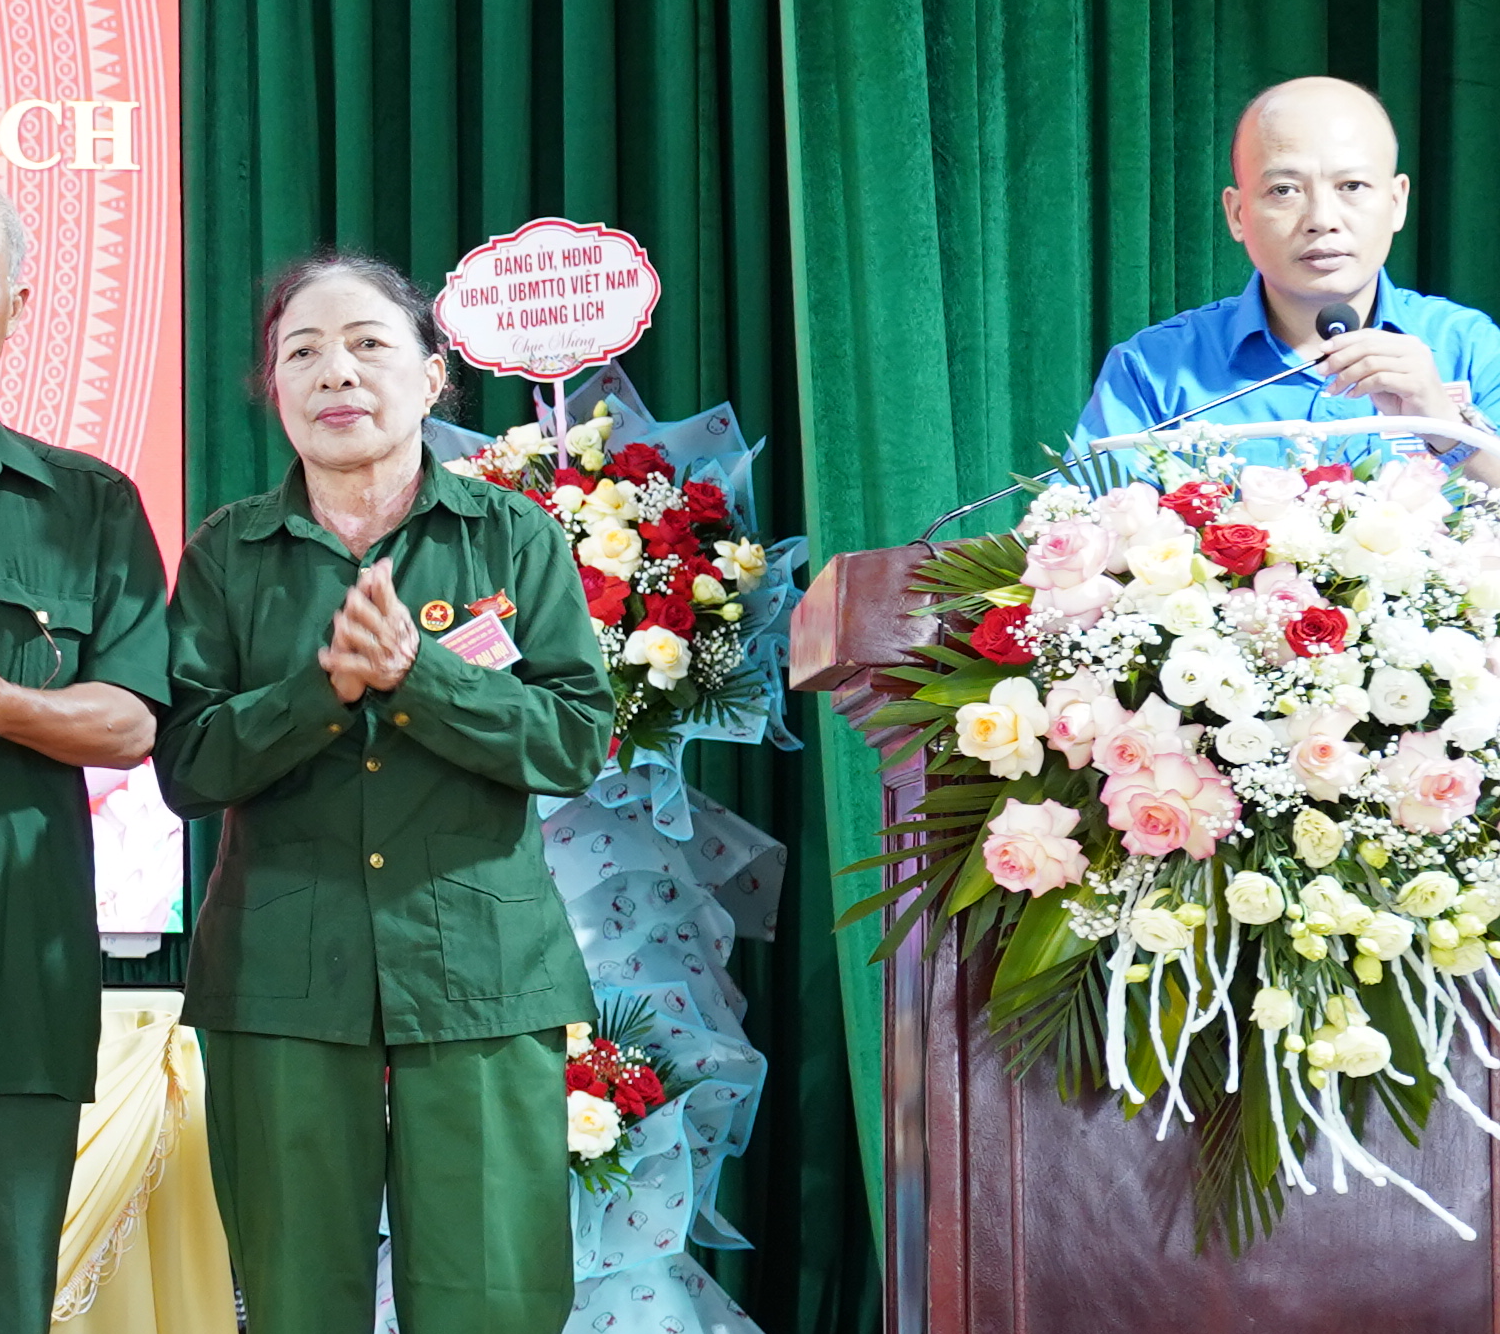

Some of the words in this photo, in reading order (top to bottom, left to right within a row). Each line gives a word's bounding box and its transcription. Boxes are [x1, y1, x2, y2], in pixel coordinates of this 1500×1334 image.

[494, 248, 532, 277] ĐẢNG
[538, 244, 558, 272] ỦY,
[562, 245, 602, 268] HĐND
[460, 286, 504, 308] UBND,
[508, 278, 566, 303] UBMTTQ
[571, 269, 600, 299] VIỆT
[606, 268, 639, 291] NAM
[496, 306, 515, 332] XÃ
[520, 305, 568, 329] QUANG
[573, 300, 605, 327] LỊCH
[512, 334, 545, 356] Chúc
